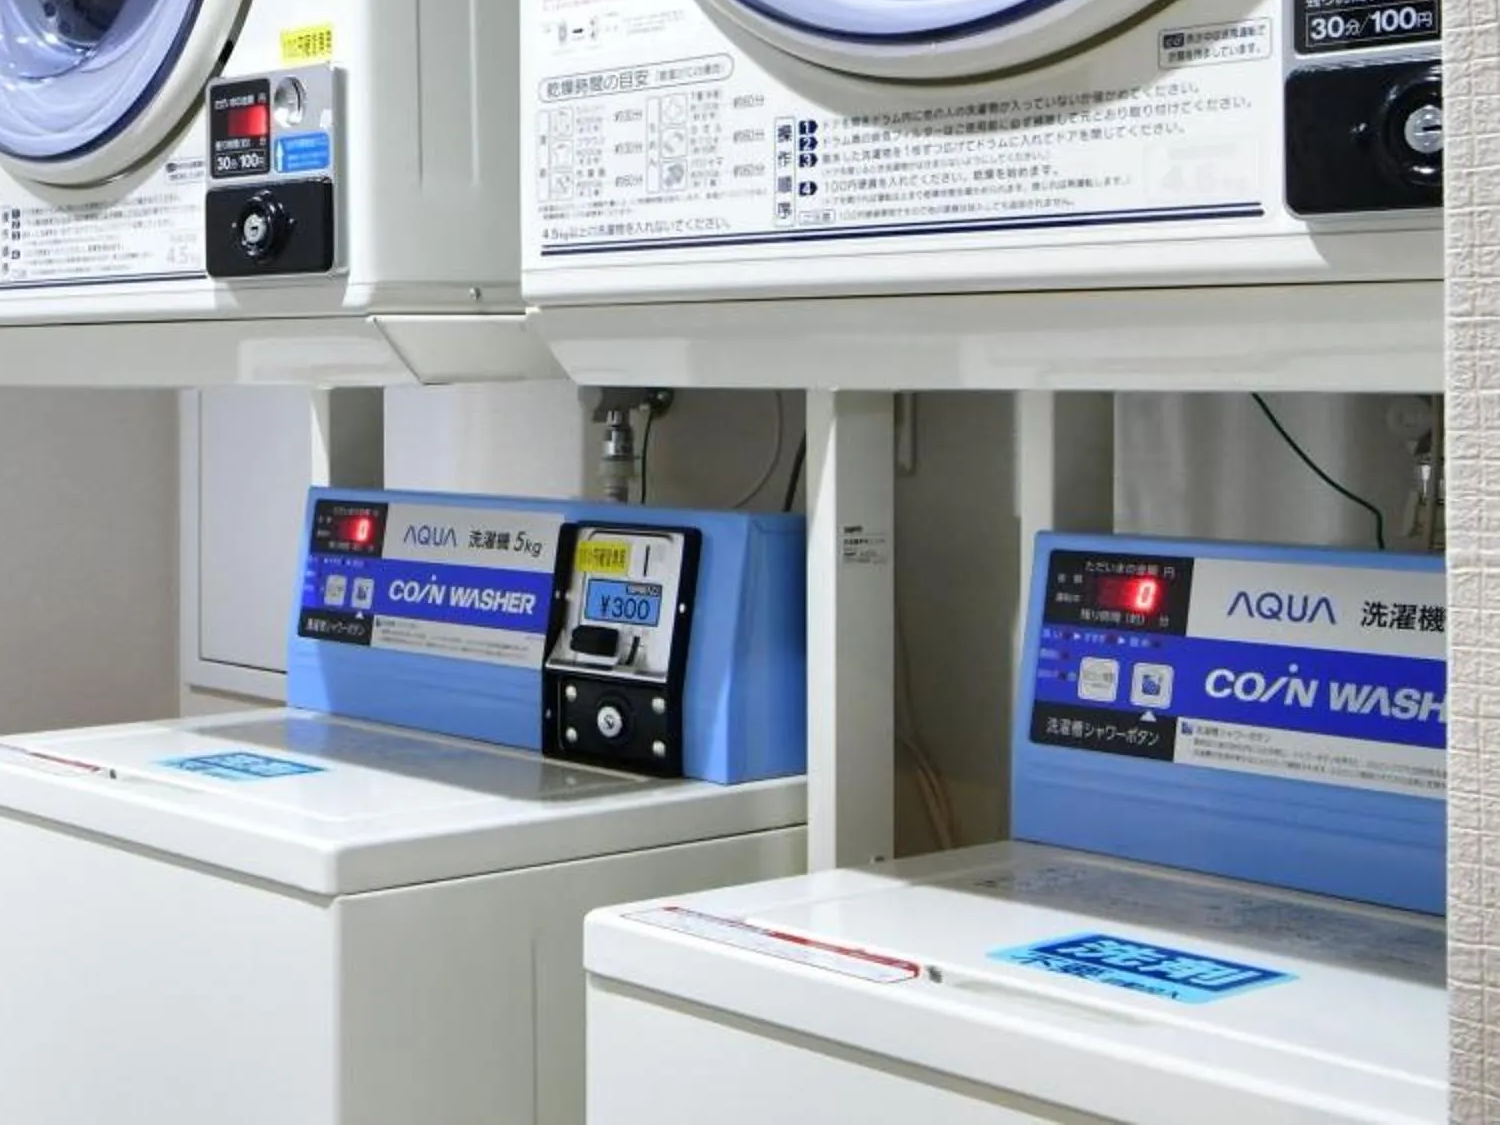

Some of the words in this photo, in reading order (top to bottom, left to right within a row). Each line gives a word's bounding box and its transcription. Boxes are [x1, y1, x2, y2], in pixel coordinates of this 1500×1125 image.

[356, 518, 370, 542] 0
[403, 525, 457, 547] AQUA
[468, 530, 511, 550] 洗濯機
[513, 531, 543, 557] 5kg
[450, 586, 537, 615] WASHER
[601, 594, 651, 620] ¥300
[1135, 581, 1157, 610] 0
[1227, 590, 1337, 625] AQUA
[1360, 600, 1445, 633] 洗濯機
